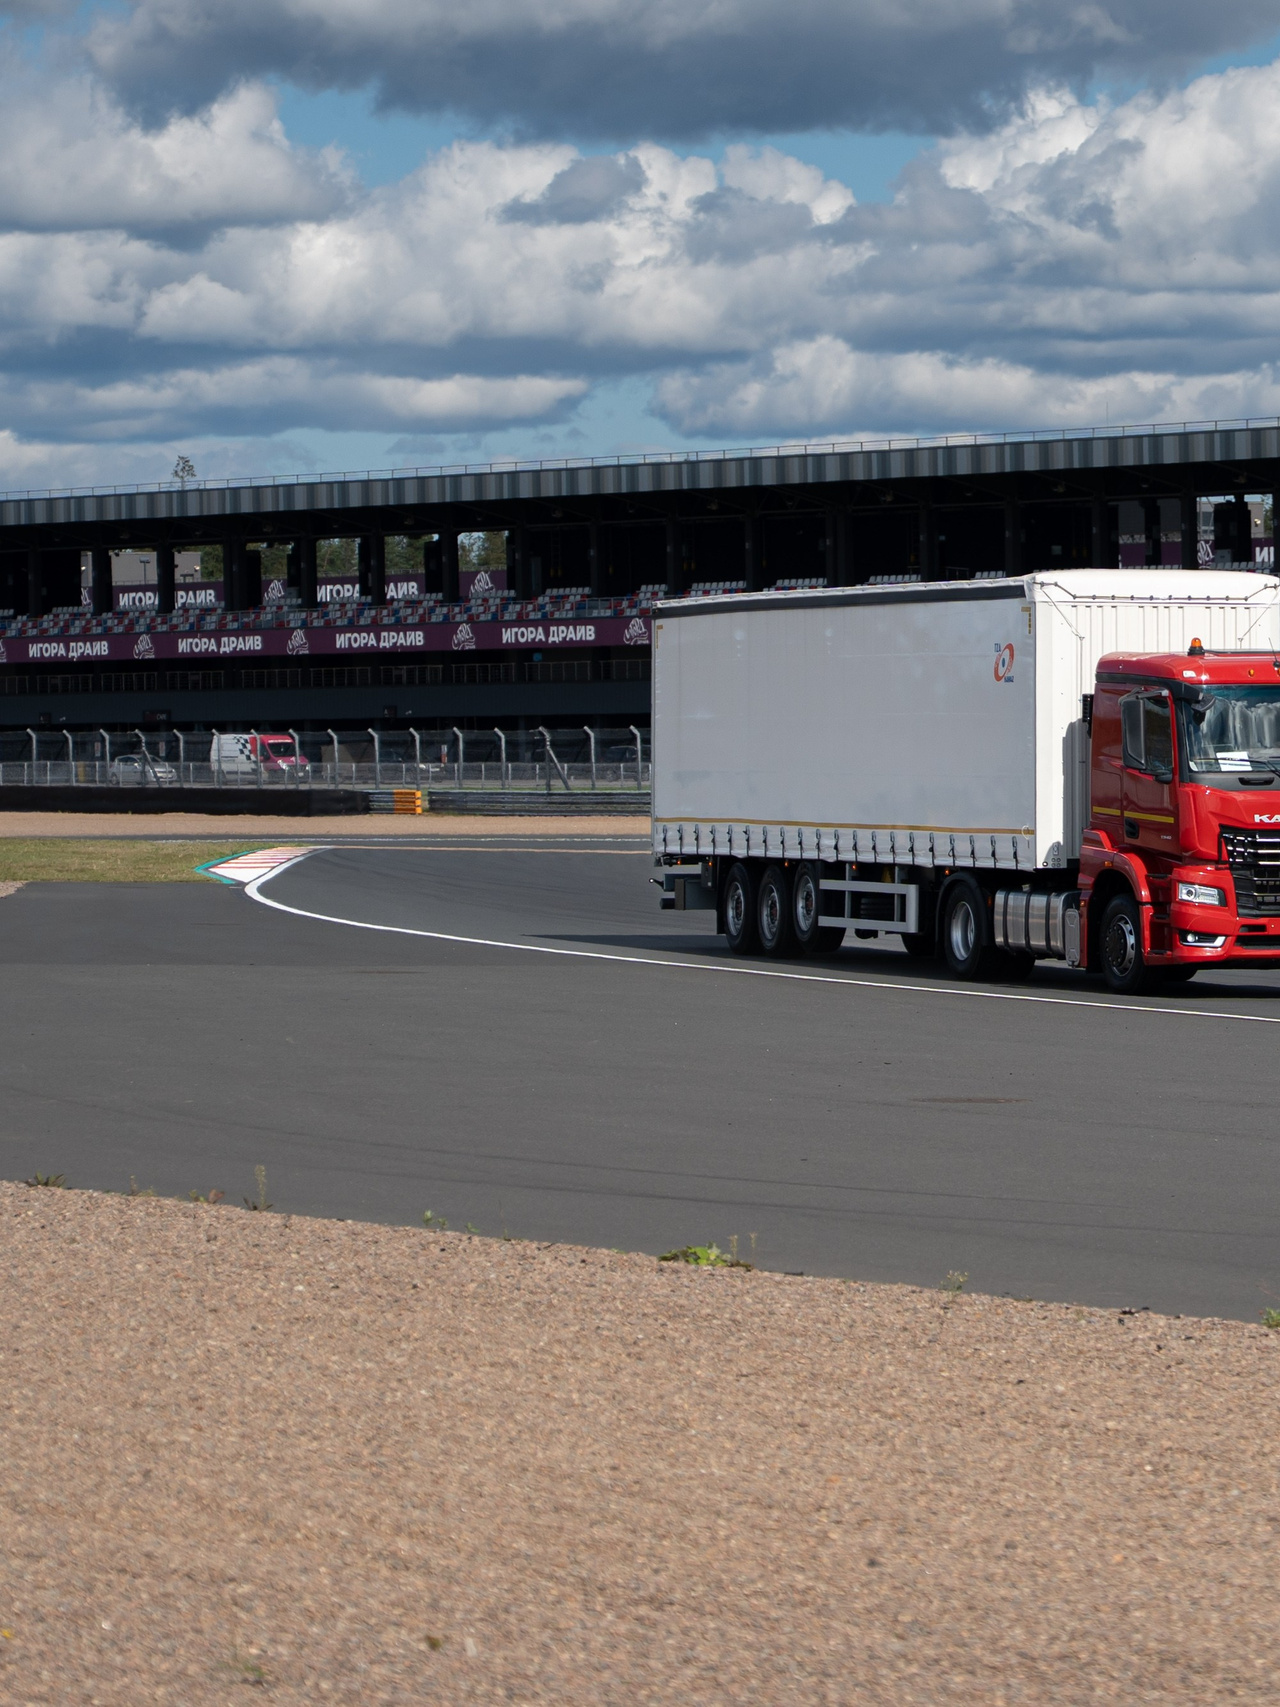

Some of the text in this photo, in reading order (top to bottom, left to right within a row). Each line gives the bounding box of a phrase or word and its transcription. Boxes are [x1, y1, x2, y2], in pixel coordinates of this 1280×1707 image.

[175, 590, 215, 609] РАЙВ
[336, 631, 424, 648] ИГОРА ДРАЙВ
[502, 625, 595, 643] ИГОРА ДРАЙВ
[28, 641, 109, 659] ИГОРА ДРАЙВ
[178, 636, 262, 654] ИГОРА ДРАЙВ
